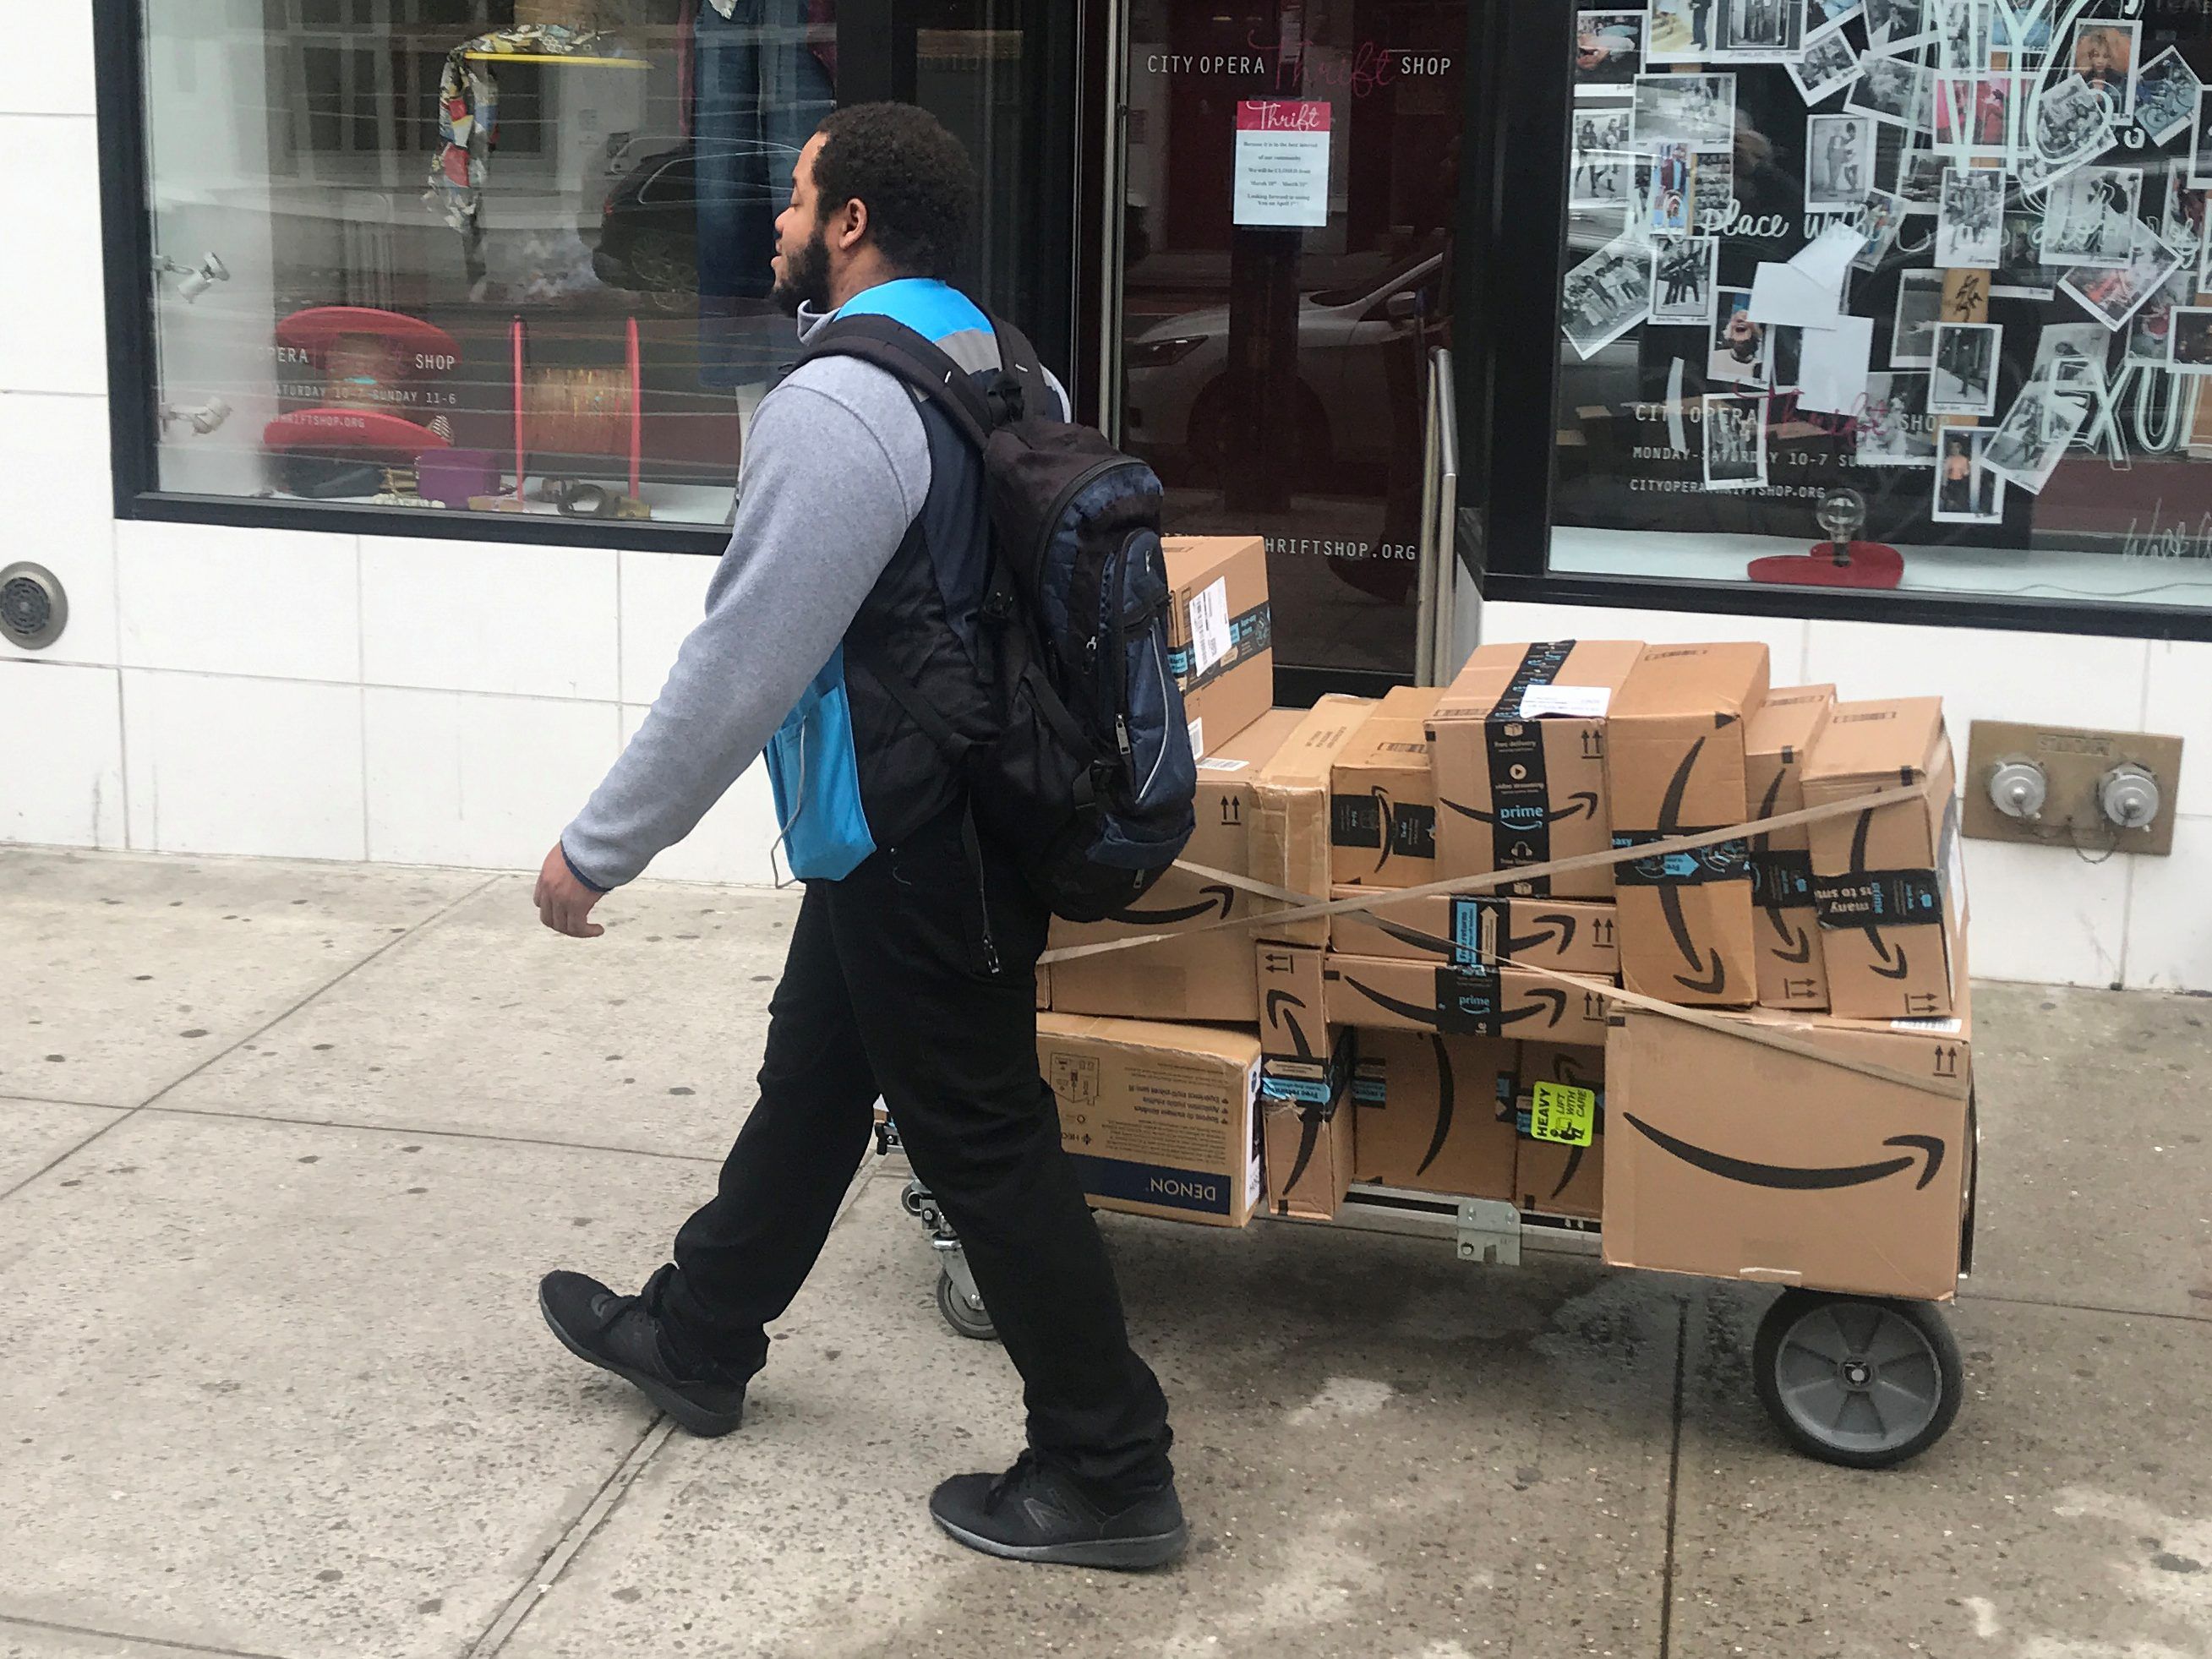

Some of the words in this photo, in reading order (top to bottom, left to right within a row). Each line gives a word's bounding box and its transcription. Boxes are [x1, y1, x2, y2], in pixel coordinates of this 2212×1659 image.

[1147, 55, 1193, 74] CITY
[1199, 56, 1265, 74] OPERA
[1400, 56, 1452, 76] SHOP
[1245, 101, 1320, 132] Thrift
[1691, 197, 1790, 267] place
[415, 353, 456, 370] SHOP
[370, 389, 418, 402] SUNDAY
[425, 392, 457, 405] 11-6
[1635, 404, 1684, 422] CIT
[1632, 446, 1779, 466] MONDAY-ATURDY
[1789, 451, 1828, 467] 10-7
[1499, 805, 1543, 819] prime
[1829, 902, 1870, 914] many
[1458, 994, 1490, 1006] prime
[1537, 1087, 1551, 1138] HEAVY
[1556, 1092, 1565, 1115] LIFT
[1565, 1089, 1576, 1116] WITH
[1576, 1089, 1587, 1118] CARE
[1150, 1176, 1216, 1202] DENON
